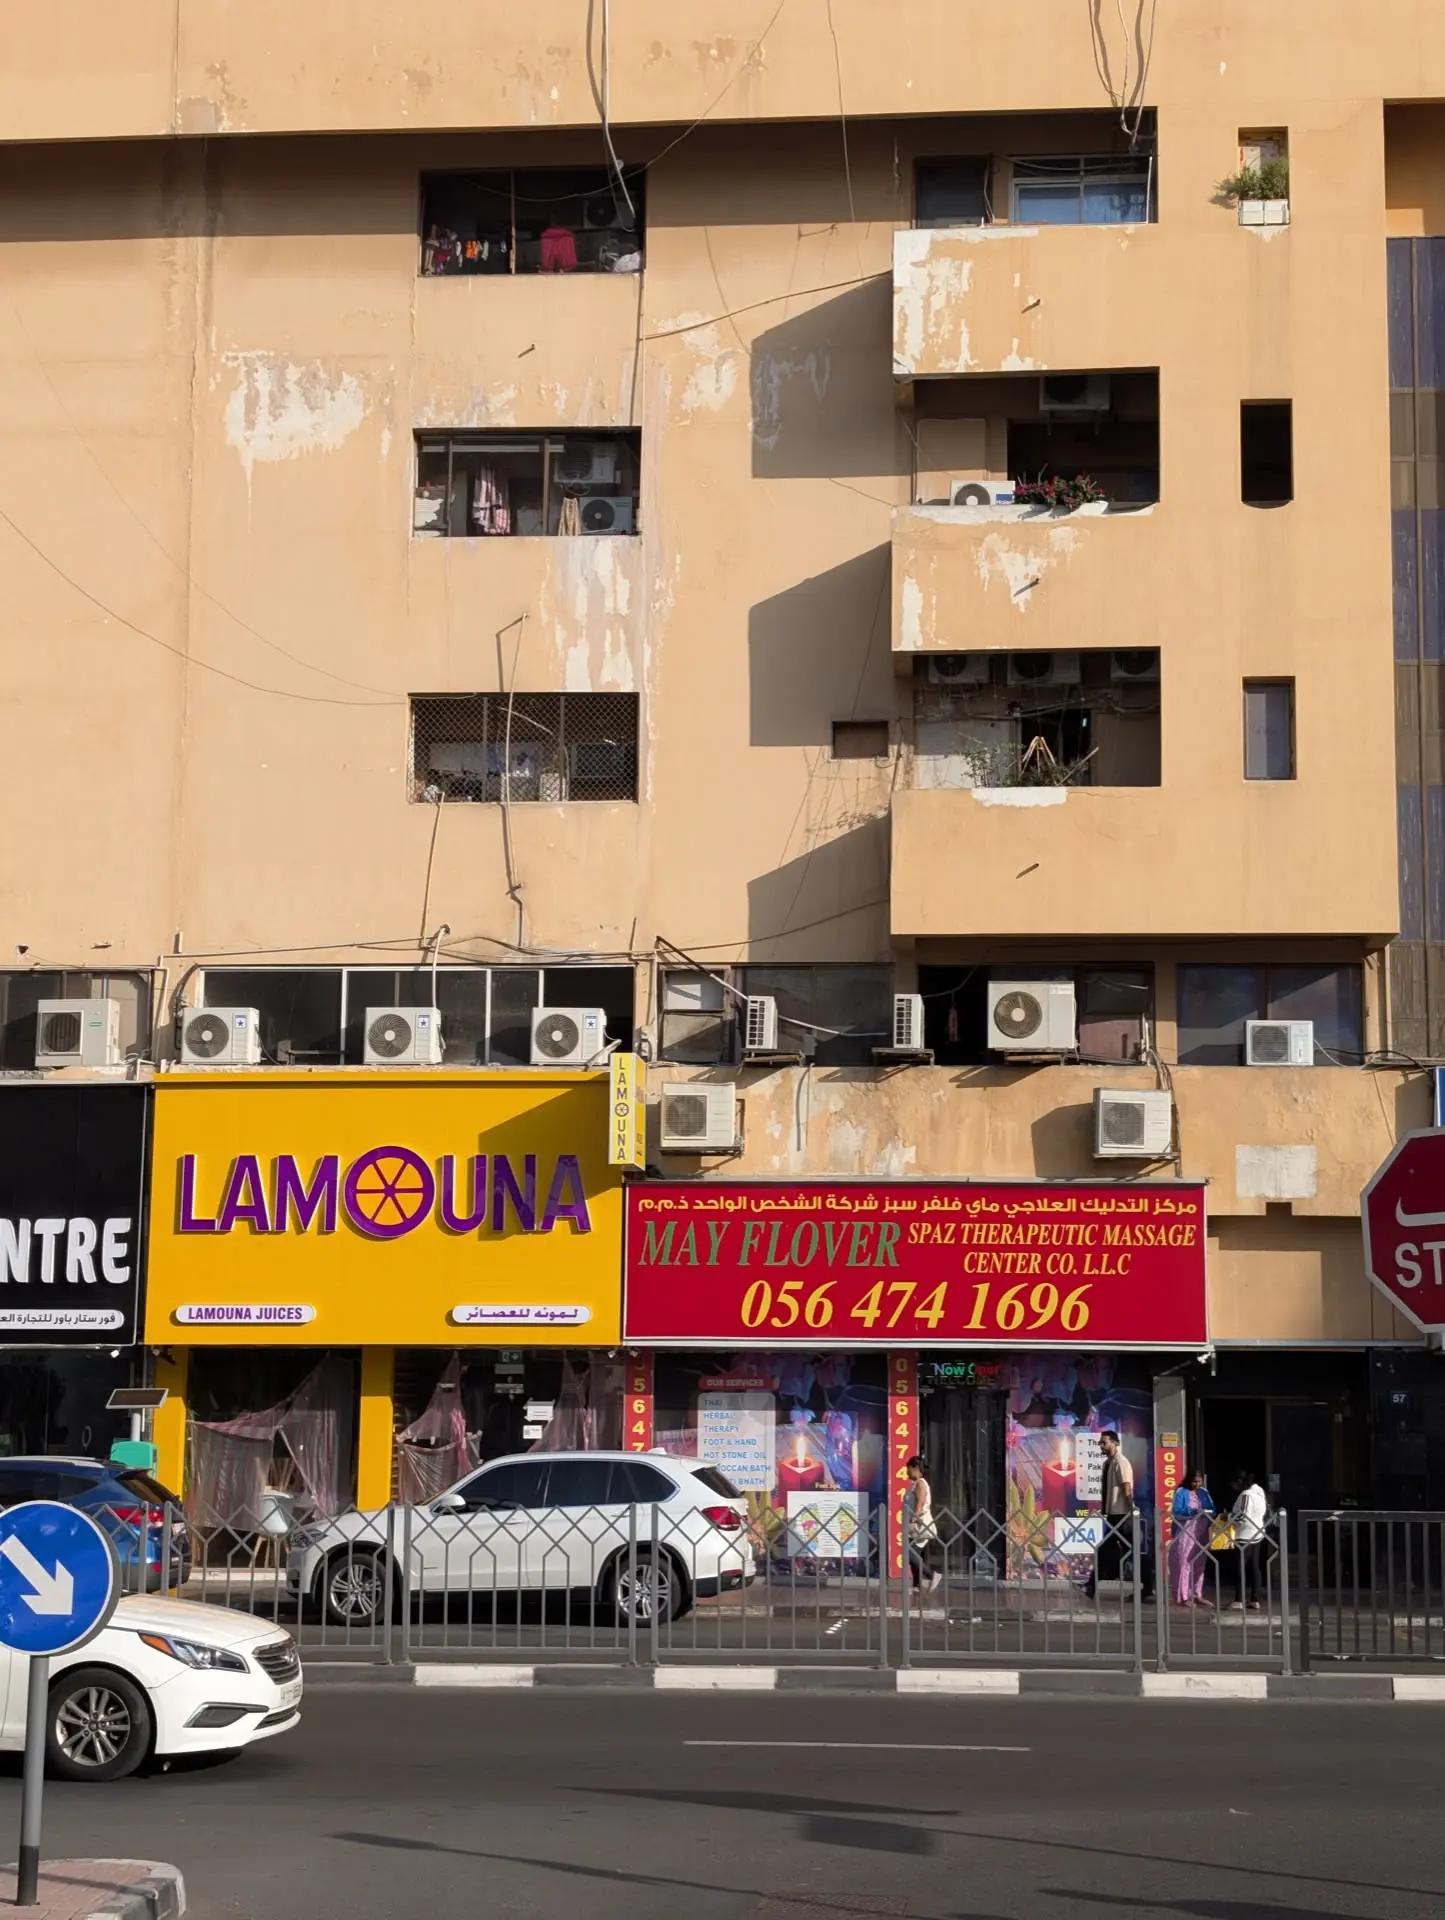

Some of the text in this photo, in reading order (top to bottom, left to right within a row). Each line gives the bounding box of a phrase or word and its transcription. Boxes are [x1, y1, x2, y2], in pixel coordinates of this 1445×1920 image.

[615, 1056, 629, 1160] LAMOUNA
[178, 1146, 592, 1238] LAMOUNA
[693, 1196, 747, 1212] الواحد
[751, 1193, 822, 1213] الشخص
[826, 1193, 879, 1213] شركة
[883, 1196, 917, 1213] سبز
[966, 1197, 1000, 1218] ماي
[1003, 1198, 1077, 1218] العلاجي
[1080, 1198, 1149, 1215] التدليك
[1153, 1198, 1197, 1215] مركز
[908, 1222, 1197, 1247] SPAZ THERAPEUTIC MASSAGE
[0, 1217, 131, 1284] NTRE
[638, 1220, 901, 1268] MAY FLOVER
[963, 1251, 1132, 1276] CENTER CO. L.L.C
[1395, 1241, 1445, 1288] ST
[188, 1307, 303, 1320] LAMOUNA JUICES
[740, 1280, 1093, 1332] 056 474 1696
[17, 1313, 52, 1325] للتجارة
[53, 1313, 72, 1325] باور
[73, 1313, 97, 1325] ستار
[98, 1312, 116, 1325] فور
[703, 1425, 739, 1433] THERAPY
[703, 1438, 725, 1446] FOOT
[735, 1438, 757, 1446] HAND
[722, 1451, 748, 1459] STONE
[717, 1464, 771, 1472] OCCAN BATH
[1062, 1527, 1096, 1543] VISA
